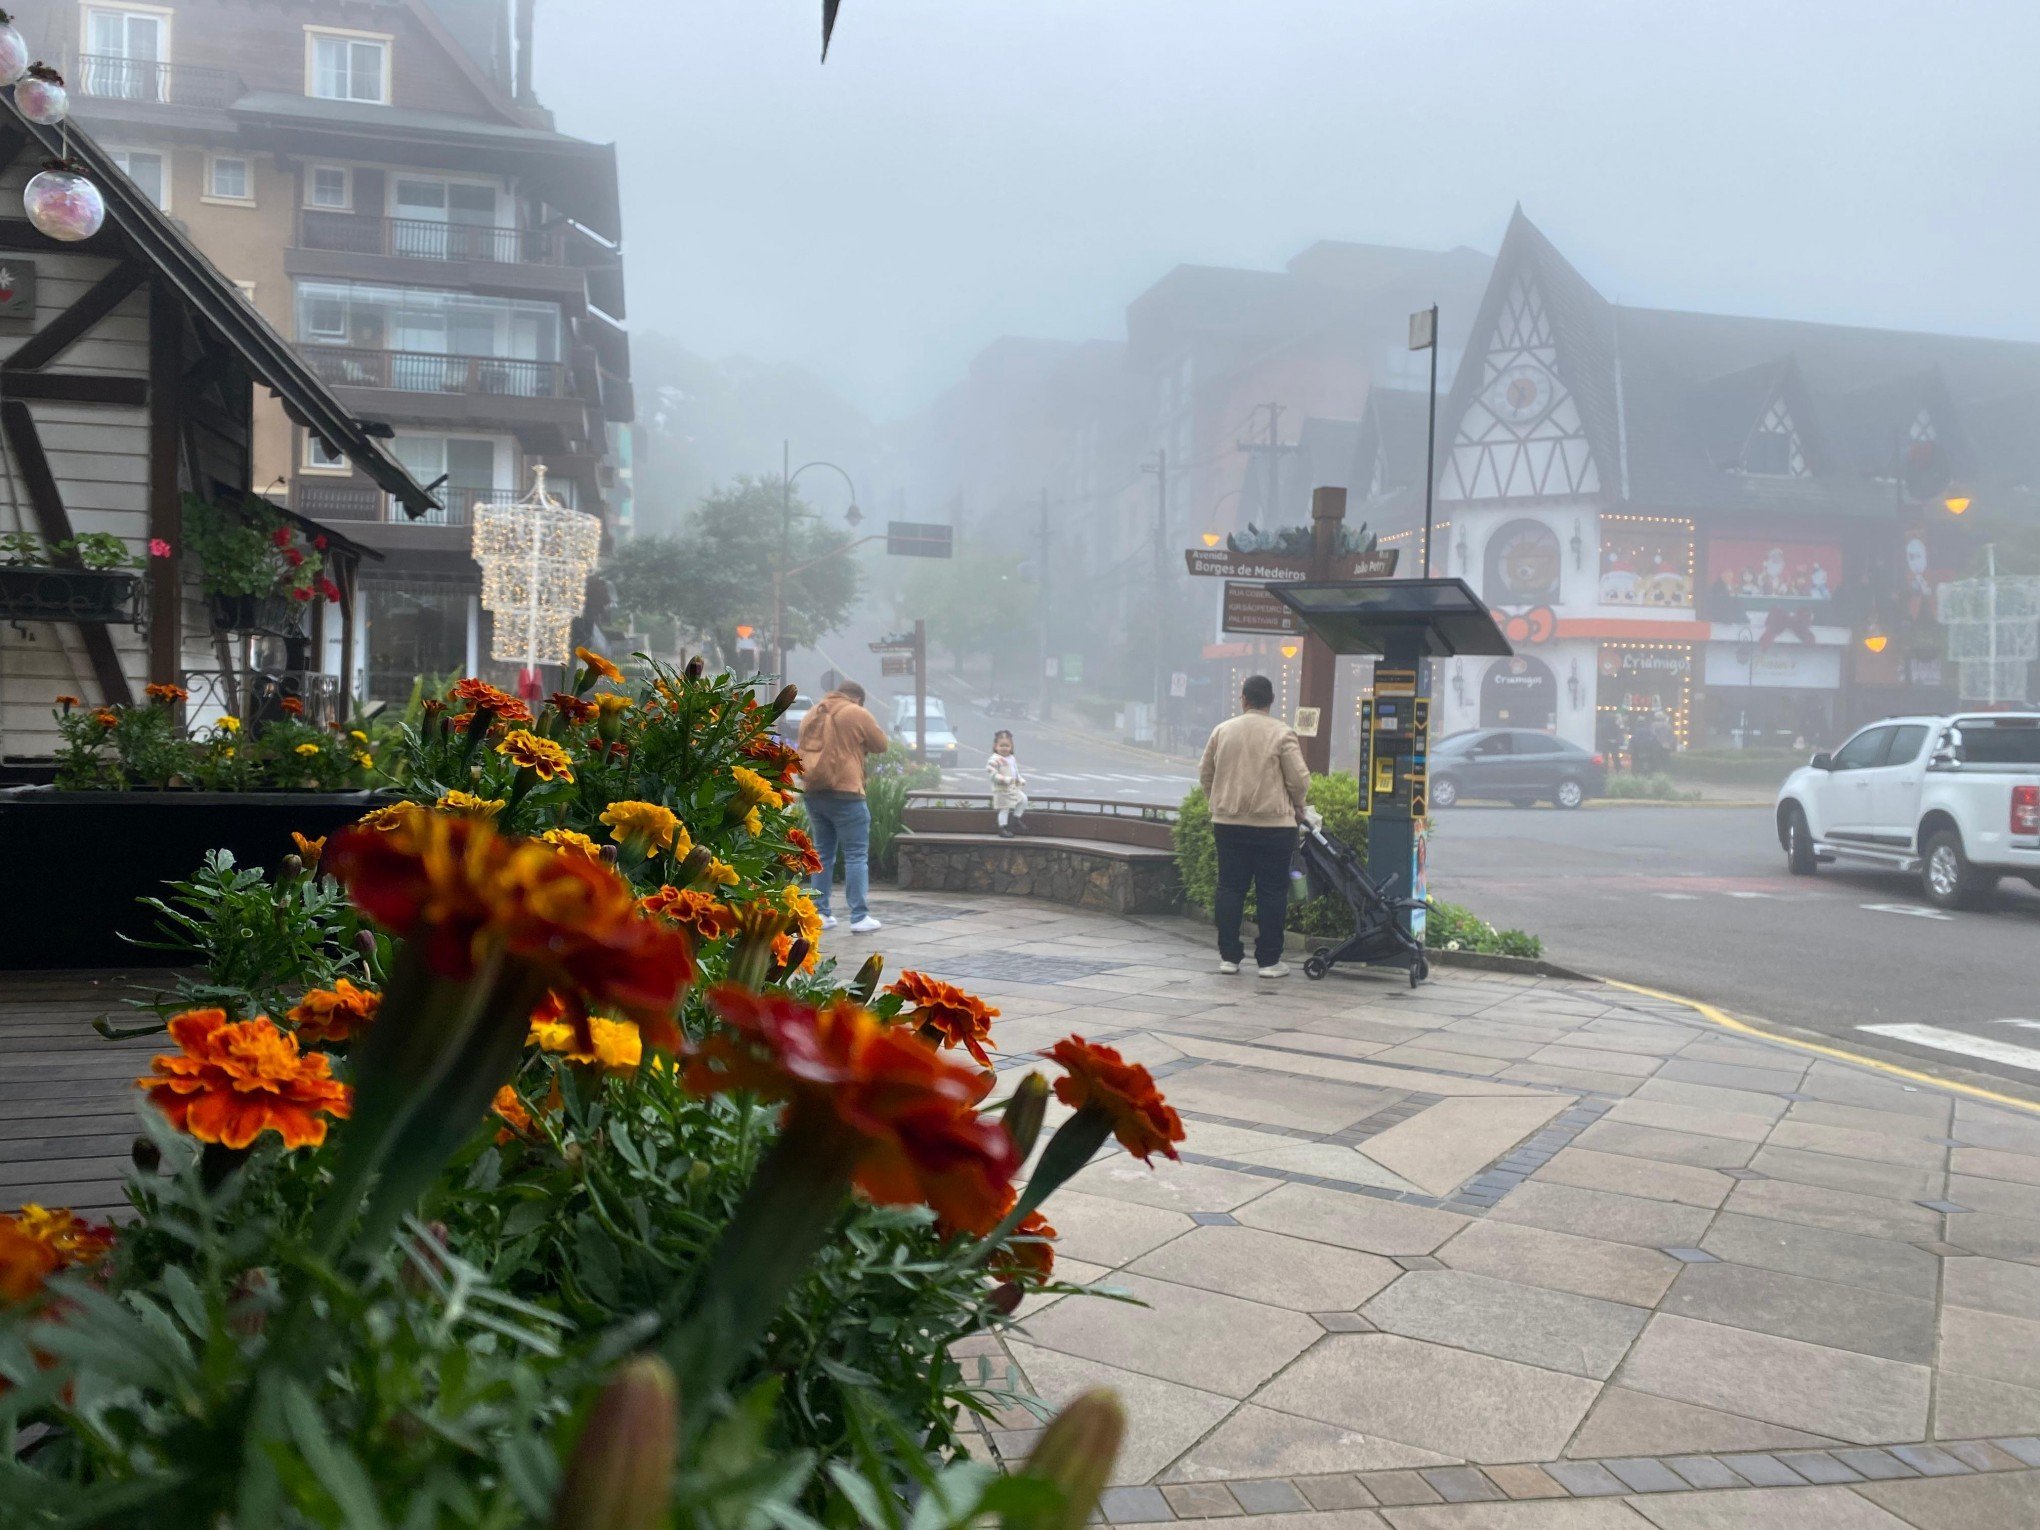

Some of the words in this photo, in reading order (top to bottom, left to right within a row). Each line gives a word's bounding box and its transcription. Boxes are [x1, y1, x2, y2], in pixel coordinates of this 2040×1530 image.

[1192, 550, 1229, 561] Avenida
[1195, 560, 1235, 576] Borges
[1237, 563, 1253, 576] de
[1254, 565, 1307, 581] Medeiros
